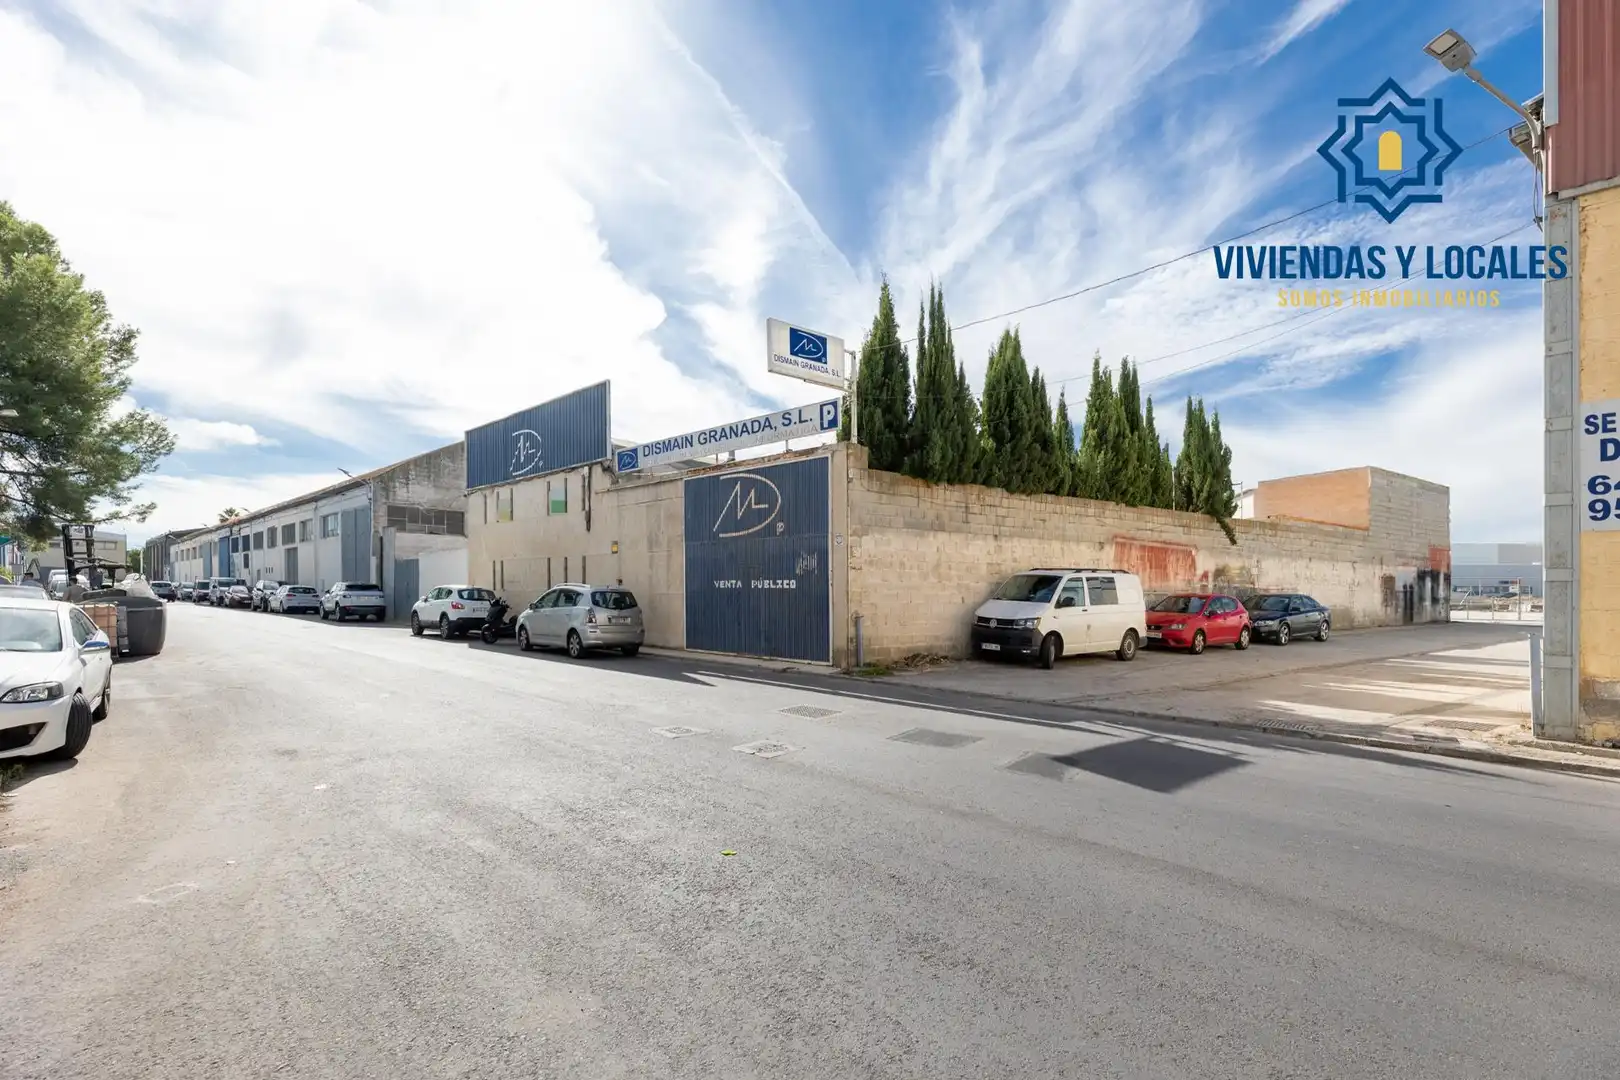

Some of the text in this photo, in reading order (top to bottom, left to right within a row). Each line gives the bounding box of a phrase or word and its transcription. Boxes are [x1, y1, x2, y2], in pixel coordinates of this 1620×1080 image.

[773, 353, 800, 368] DISMAIN
[642, 434, 694, 458] DISMAIN
[697, 416, 777, 446] GRANADA,
[781, 408, 813, 427] S.L.
[822, 404, 836, 428] P
[1584, 412, 1617, 435] SE
[714, 580, 743, 589] VENTA
